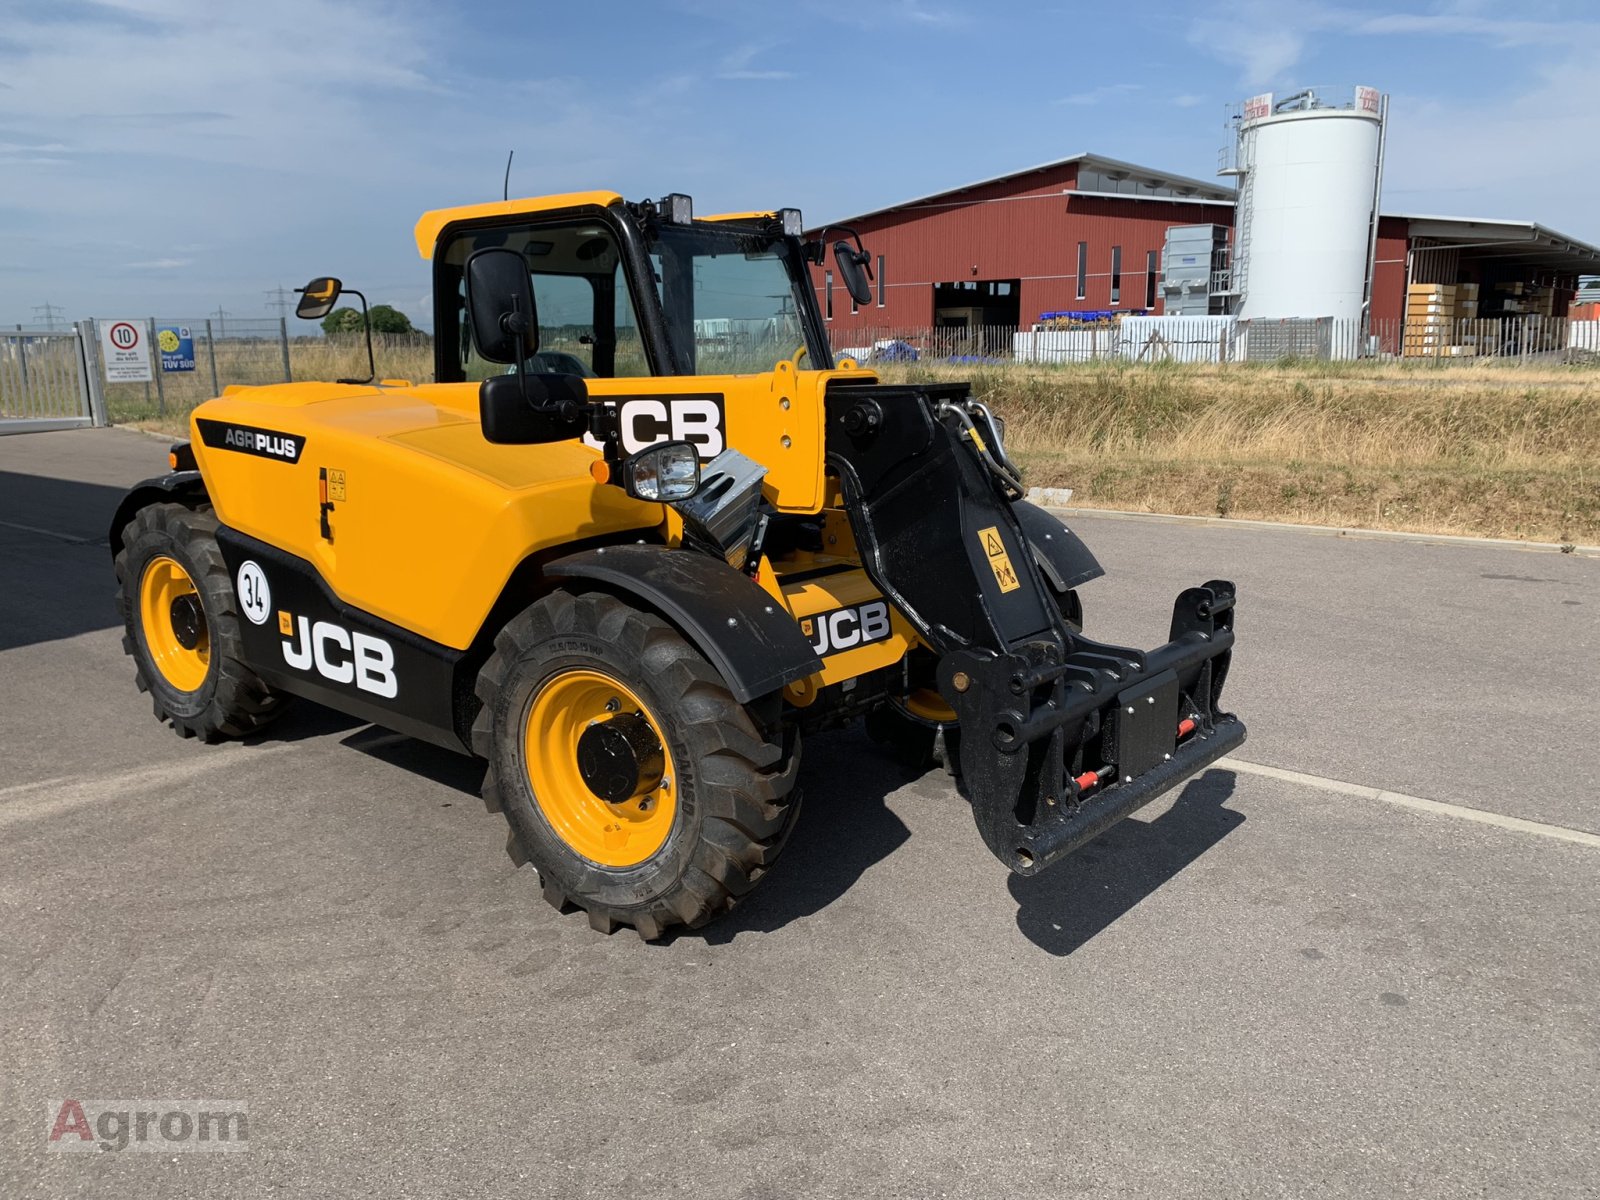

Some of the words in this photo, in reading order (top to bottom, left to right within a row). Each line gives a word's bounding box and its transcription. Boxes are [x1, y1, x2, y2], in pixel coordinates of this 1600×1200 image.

[117, 328, 131, 344] 10
[163, 359, 178, 369] TÜV
[180, 359, 195, 368] SÜD
[244, 573, 264, 613] 34
[809, 601, 890, 656] JCB
[281, 615, 399, 699] JCB
